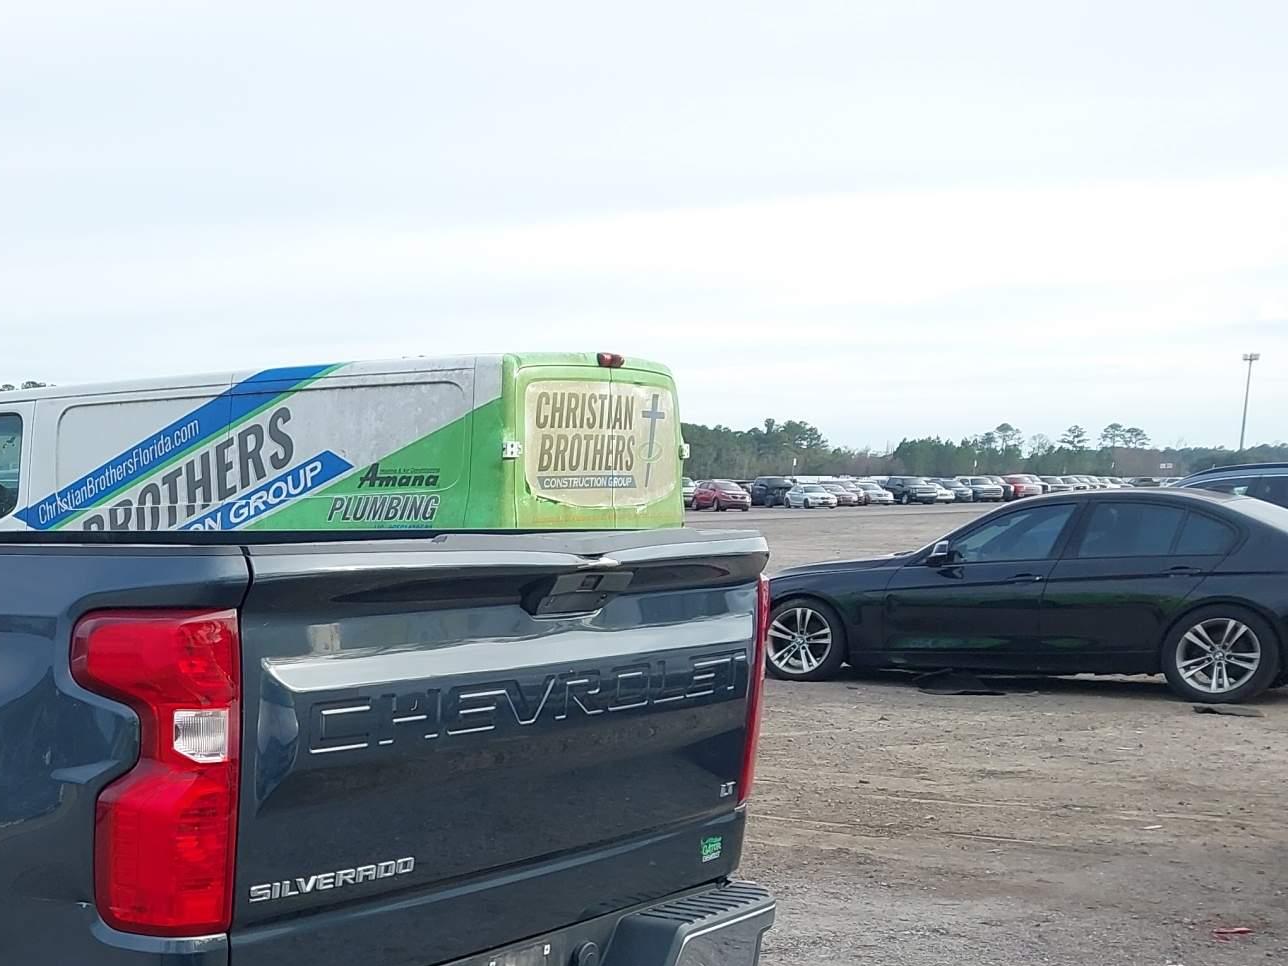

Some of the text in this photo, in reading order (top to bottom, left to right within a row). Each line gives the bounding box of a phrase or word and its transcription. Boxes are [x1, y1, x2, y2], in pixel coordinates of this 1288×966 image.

[535, 391, 634, 430] CHRISTIAN
[537, 432, 635, 472] BROTHERS
[38, 419, 200, 525] ChristianBrothersFlorida.com
[357, 462, 440, 488] Amana
[543, 477, 632, 488] CONSTRUCTION GROUP
[229, 460, 323, 524] GROUP
[327, 494, 441, 522] PLUMBING
[310, 648, 748, 753] CHEVROLET
[719, 781, 736, 798] LT
[248, 856, 415, 903] SILVERADO
